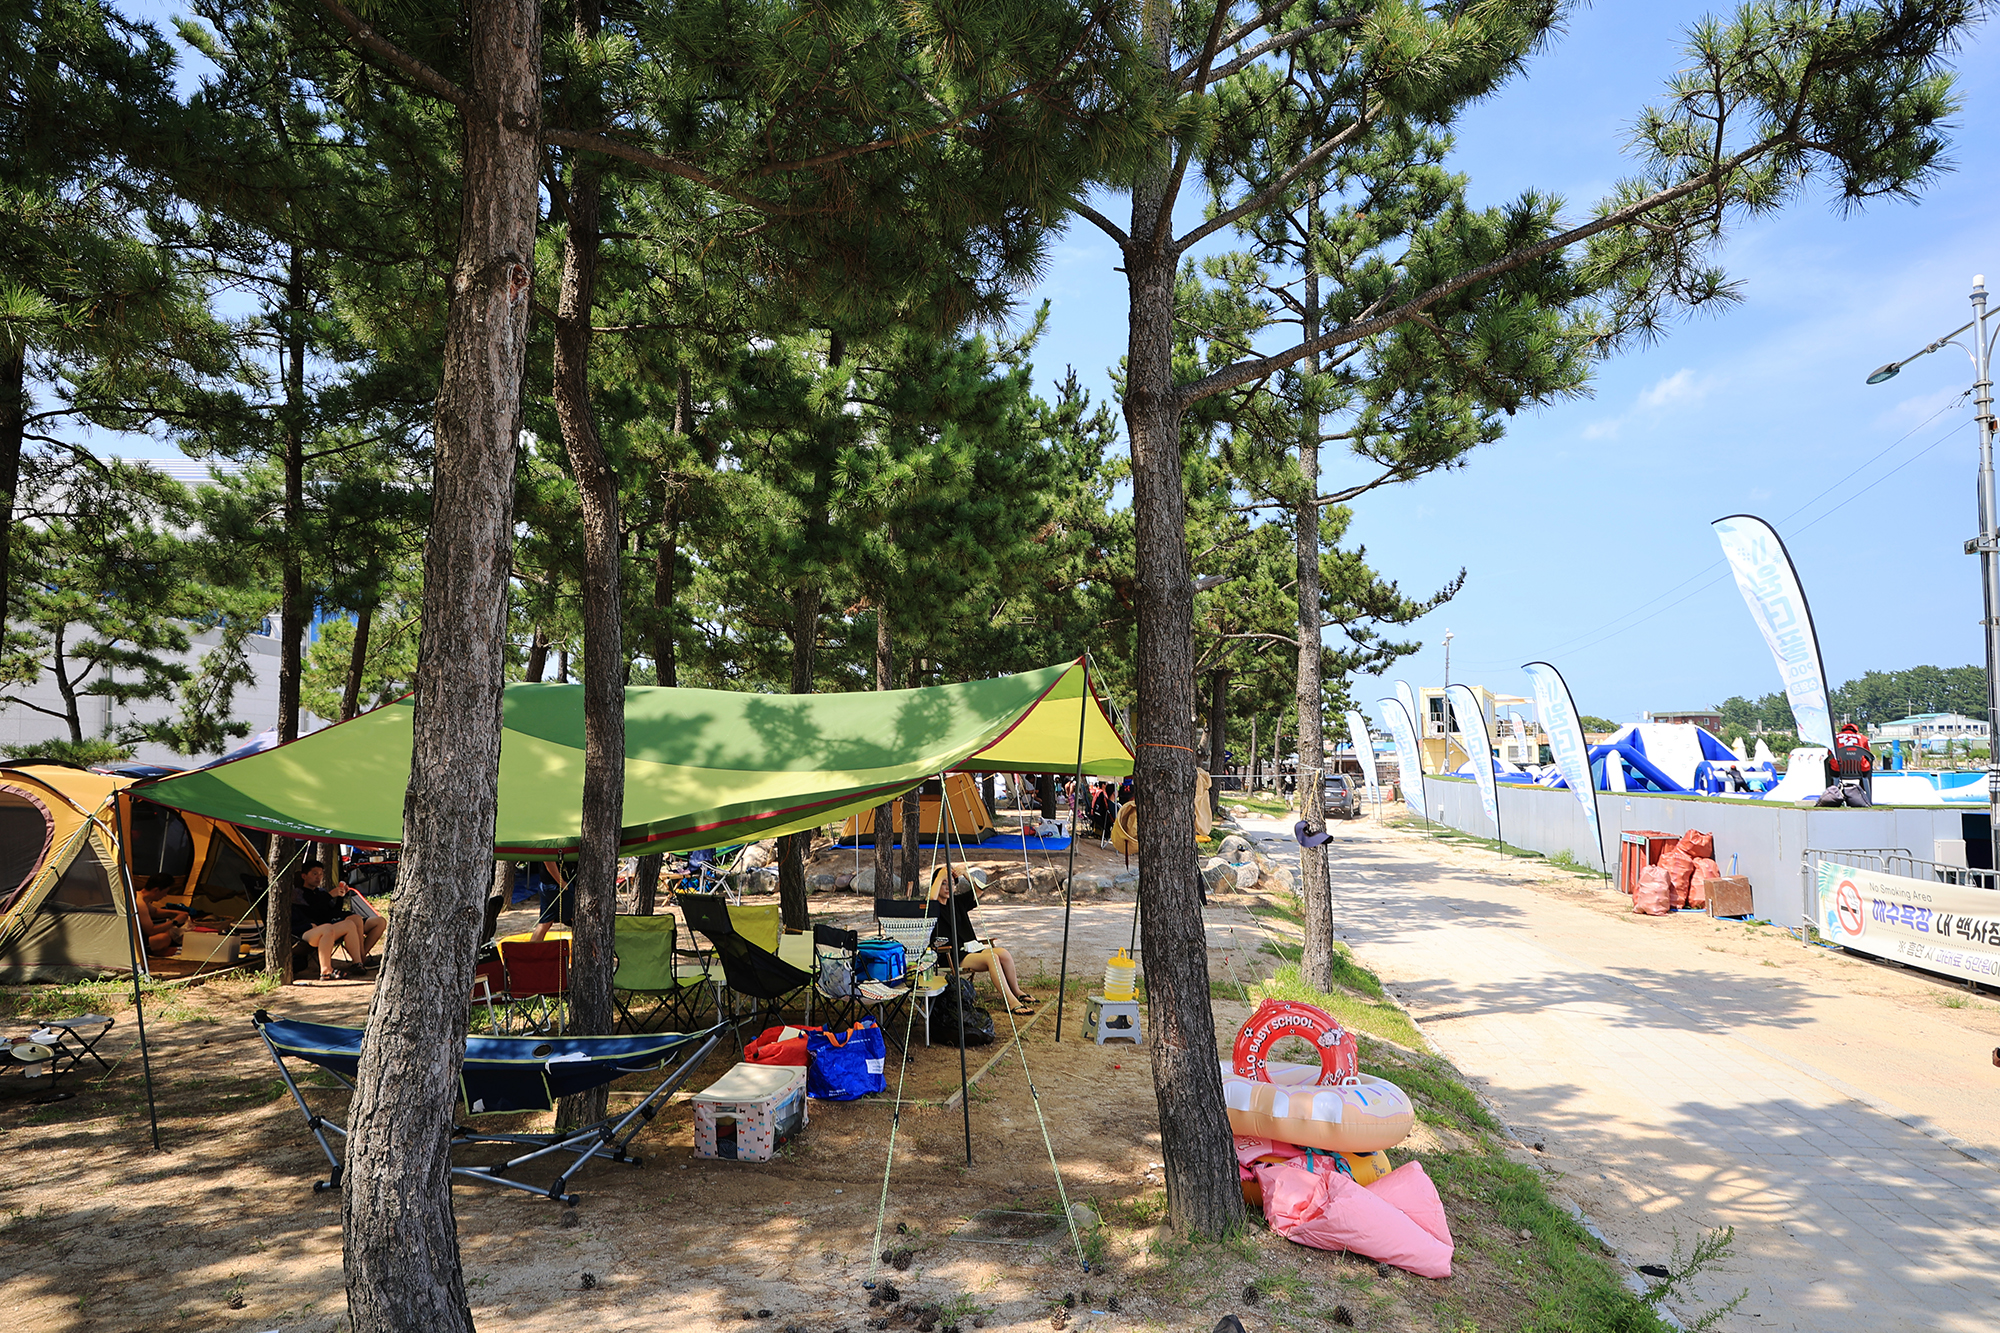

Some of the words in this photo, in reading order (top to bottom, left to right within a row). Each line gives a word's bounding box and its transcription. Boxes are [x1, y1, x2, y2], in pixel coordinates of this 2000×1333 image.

[1869, 882, 1879, 892] No
[1880, 884, 1911, 901] Smoking
[1913, 890, 1932, 903] Area
[1872, 898, 1933, 933] 해수욕장
[1936, 913, 1953, 937] 내
[1924, 946, 1936, 961] 시
[1936, 949, 1963, 968] 과태료
[1249, 1024, 1272, 1053] BABY
[1271, 1015, 1315, 1030] SCHOOL
